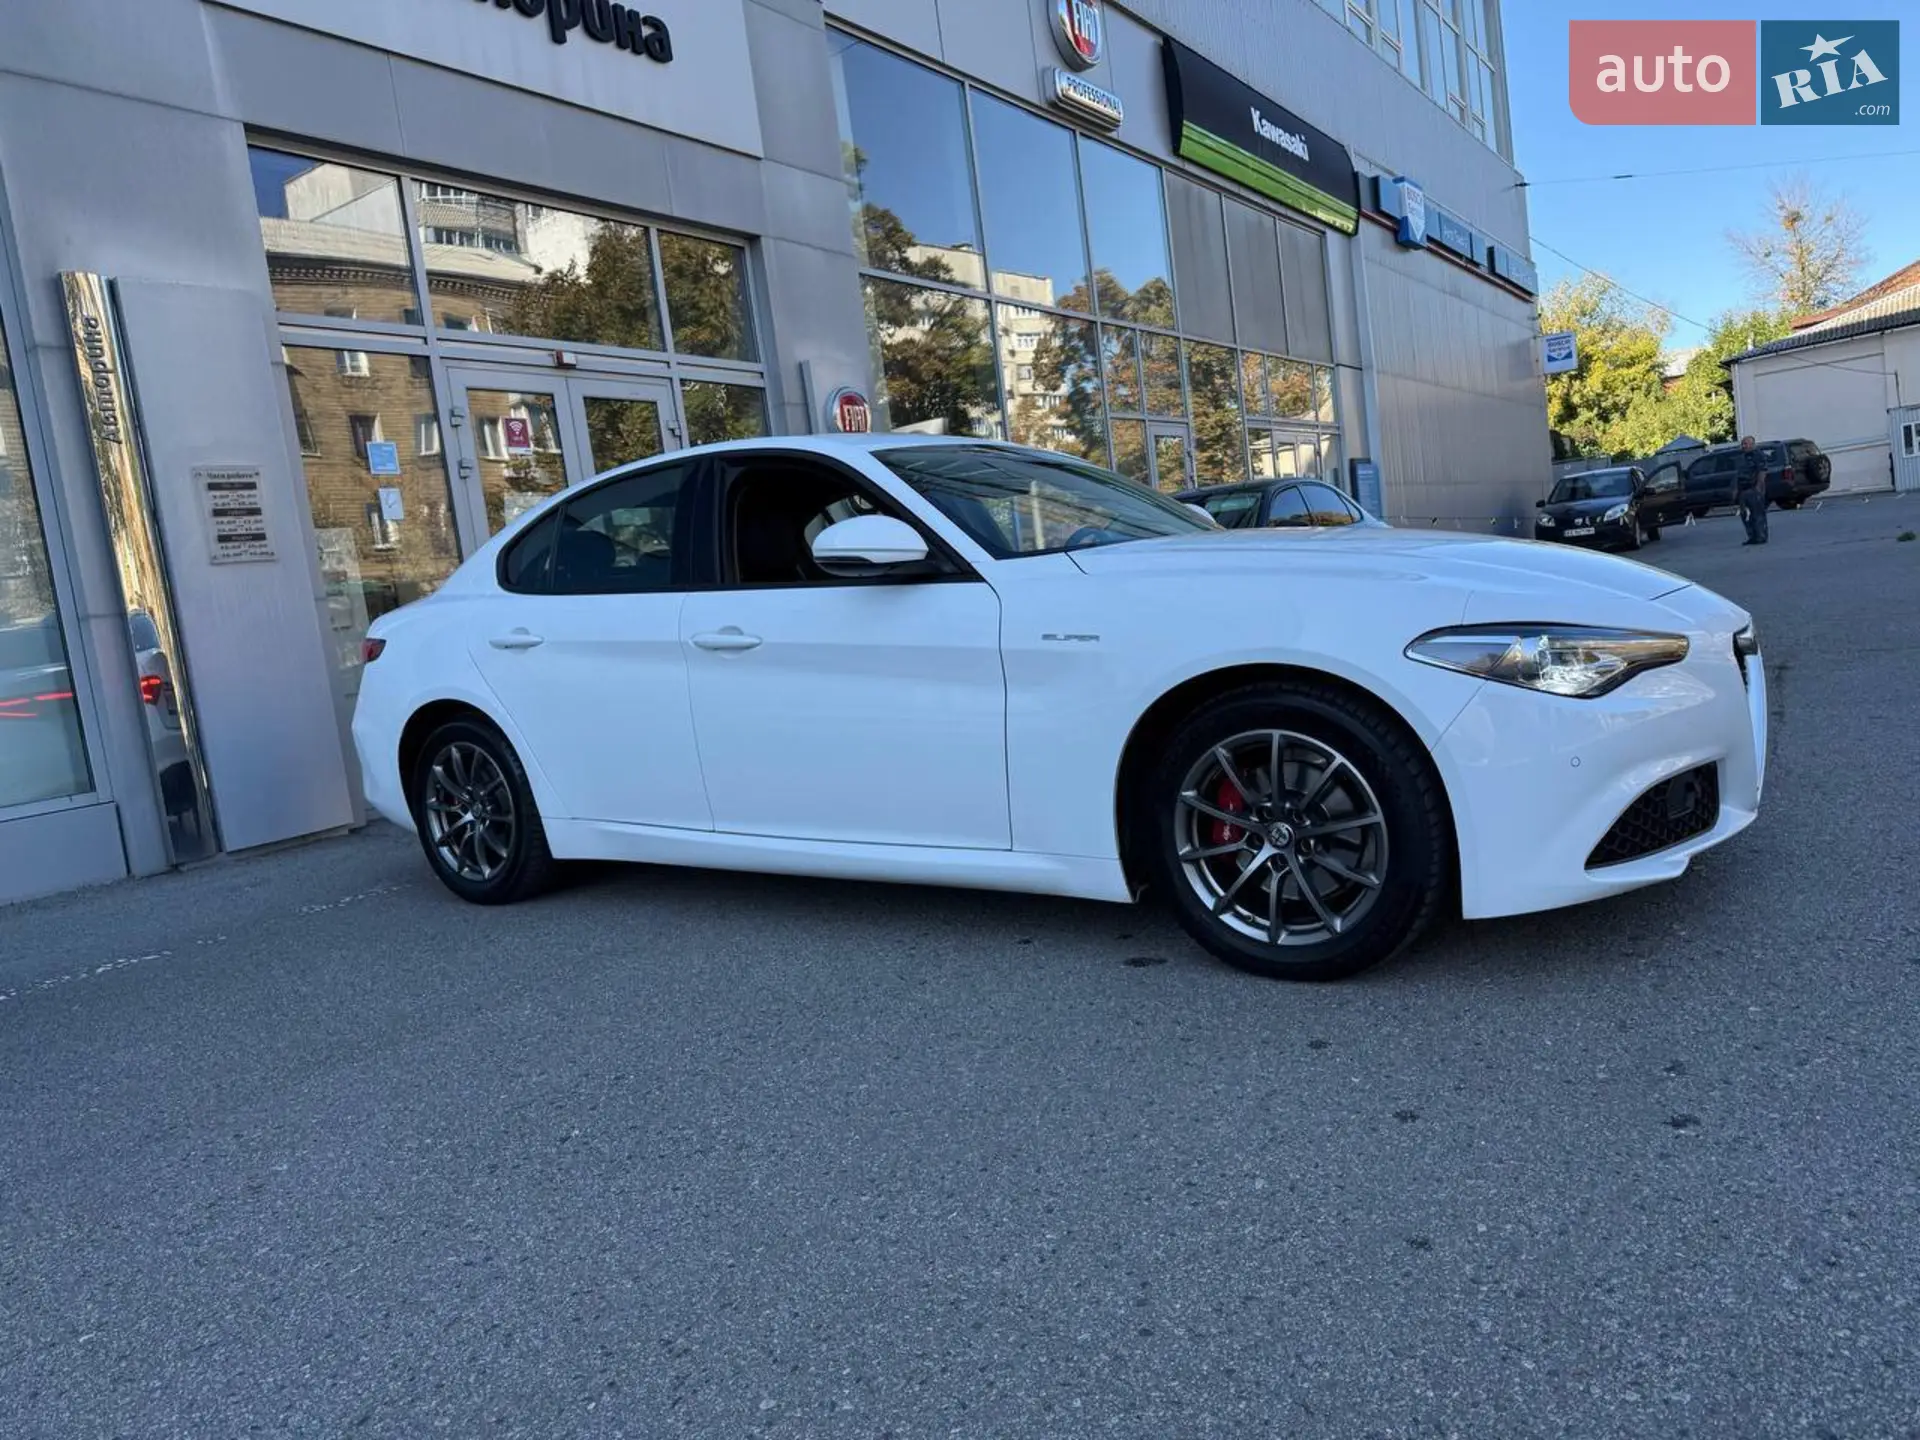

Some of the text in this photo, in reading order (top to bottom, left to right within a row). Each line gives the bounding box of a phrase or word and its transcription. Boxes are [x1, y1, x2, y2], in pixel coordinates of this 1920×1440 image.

[1067, 76, 1121, 114] PROFESSIONAL
[1249, 105, 1310, 162] Kawasaki
[842, 404, 868, 432] FIAT
